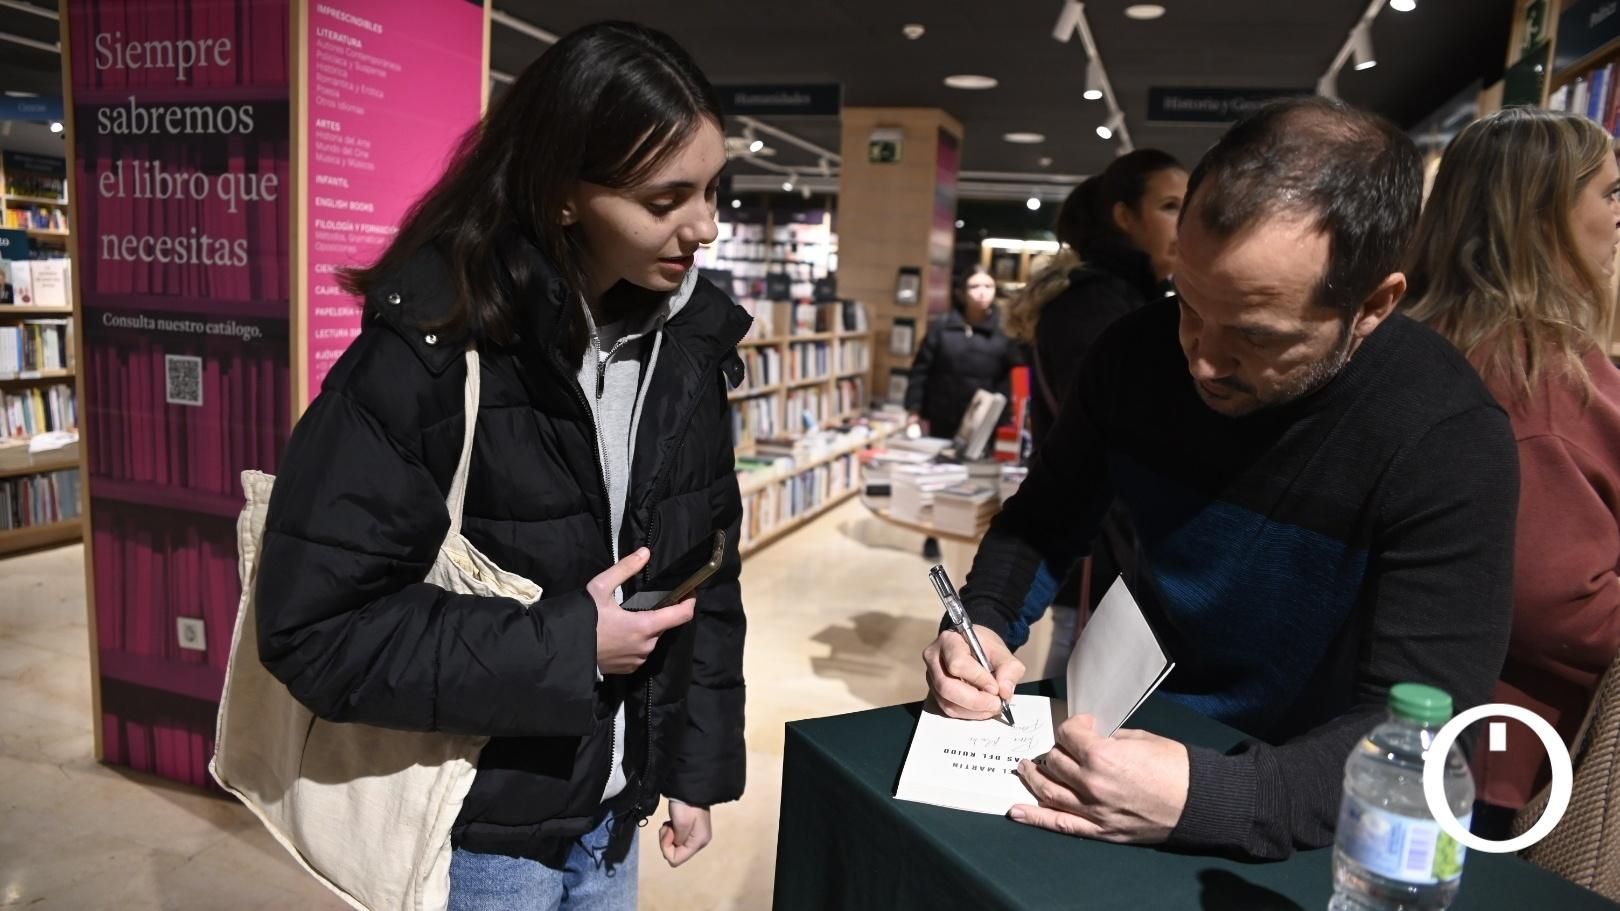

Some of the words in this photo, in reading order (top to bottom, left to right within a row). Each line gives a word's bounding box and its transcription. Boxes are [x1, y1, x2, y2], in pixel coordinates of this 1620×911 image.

[316, 3, 383, 35] IMPRESCINDIBLES
[316, 27, 362, 48] LITERATURA
[95, 31, 231, 81] Siempre
[97, 95, 254, 134] sabremos
[315, 118, 341, 132] ARTES
[99, 160, 126, 198] el
[132, 160, 209, 199] libro
[216, 171, 279, 213] que
[315, 175, 349, 189] INFANTIL
[315, 197, 348, 210] ENGLISH
[350, 201, 375, 213] BOOKS
[354, 223, 360, 232] Y
[101, 227, 248, 267] necesitas
[102, 312, 156, 330] Consulta
[157, 318, 204, 334] nuestro
[205, 320, 263, 341] catálogo.
[943, 748, 977, 758] RUIDO
[982, 752, 1001, 761] DEL
